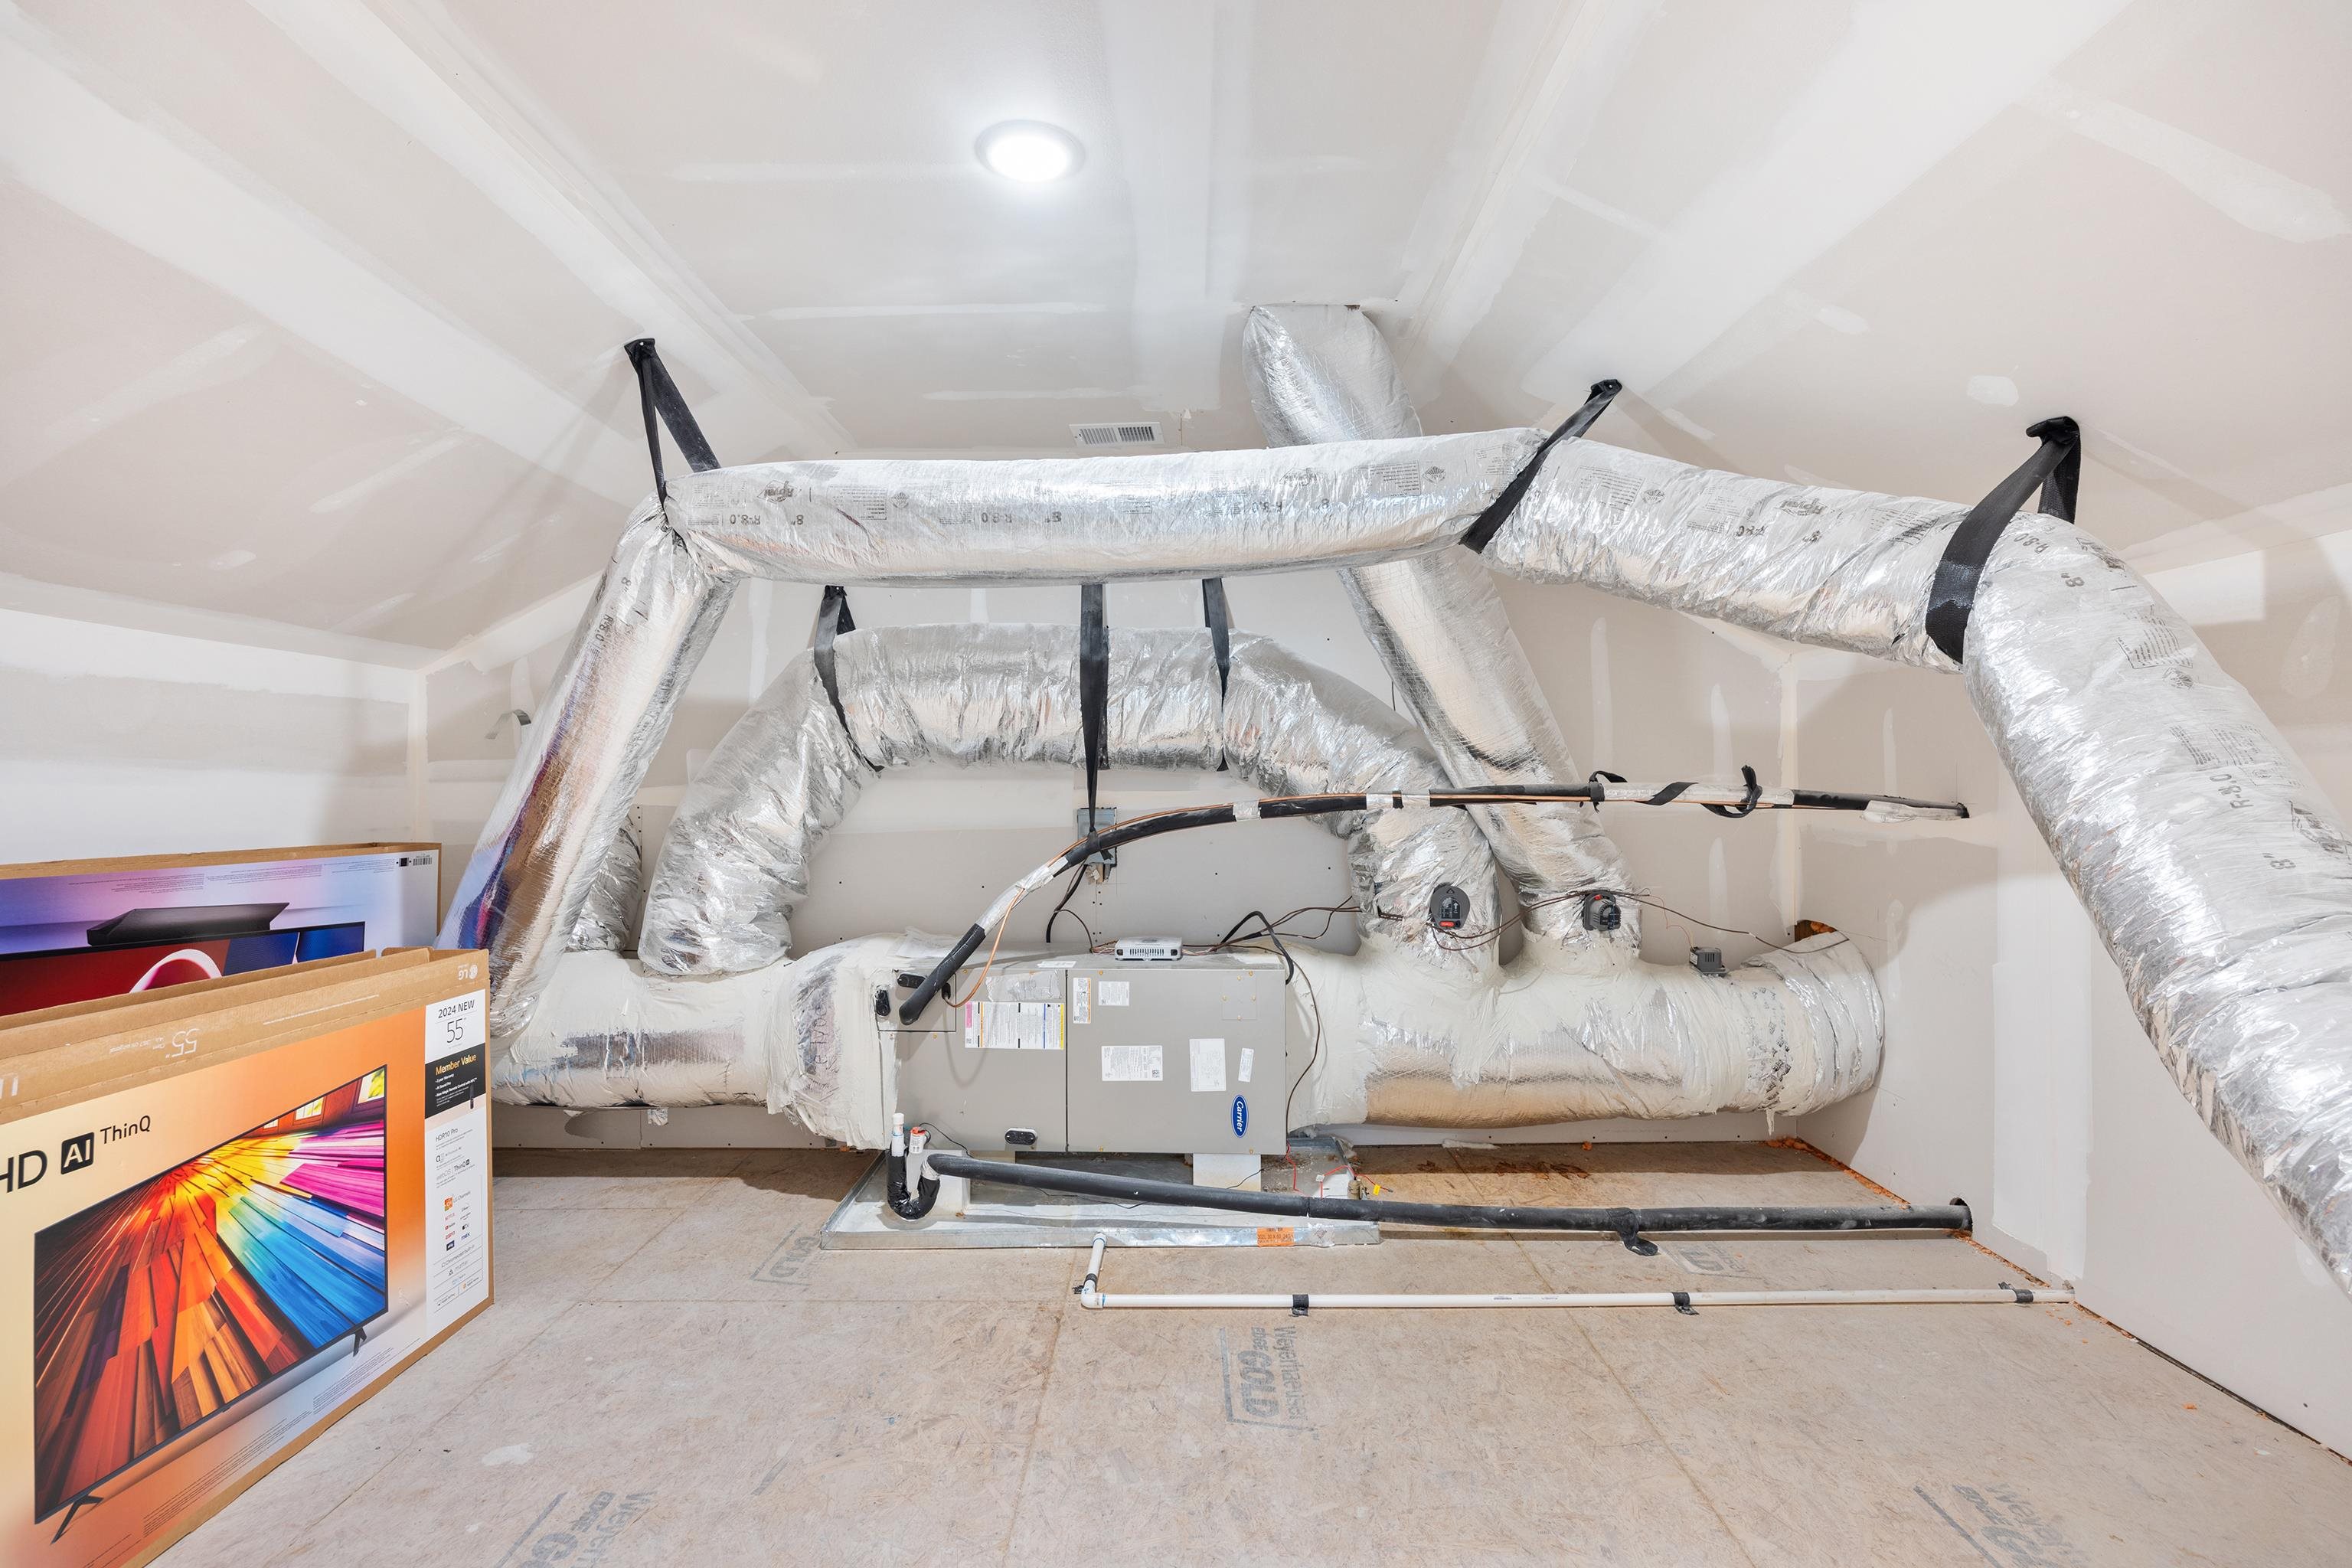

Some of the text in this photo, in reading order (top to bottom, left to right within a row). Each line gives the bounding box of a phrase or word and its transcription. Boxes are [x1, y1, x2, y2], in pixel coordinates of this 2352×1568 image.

[2013, 533, 2086, 587] 8" R-8.0
[2262, 852, 2297, 870] 8"
[438, 999, 475, 1019] 2024 NEW
[435, 1054, 477, 1076] Member Value
[1236, 1100, 1245, 1133] Carrier
[100, 1115, 151, 1144] ThinQ
[436, 1130, 450, 1142] HDR10
[63, 1138, 92, 1169] AI
[453, 1160, 466, 1171] ThinQ
[1237, 1350, 1280, 1418] GOLD
